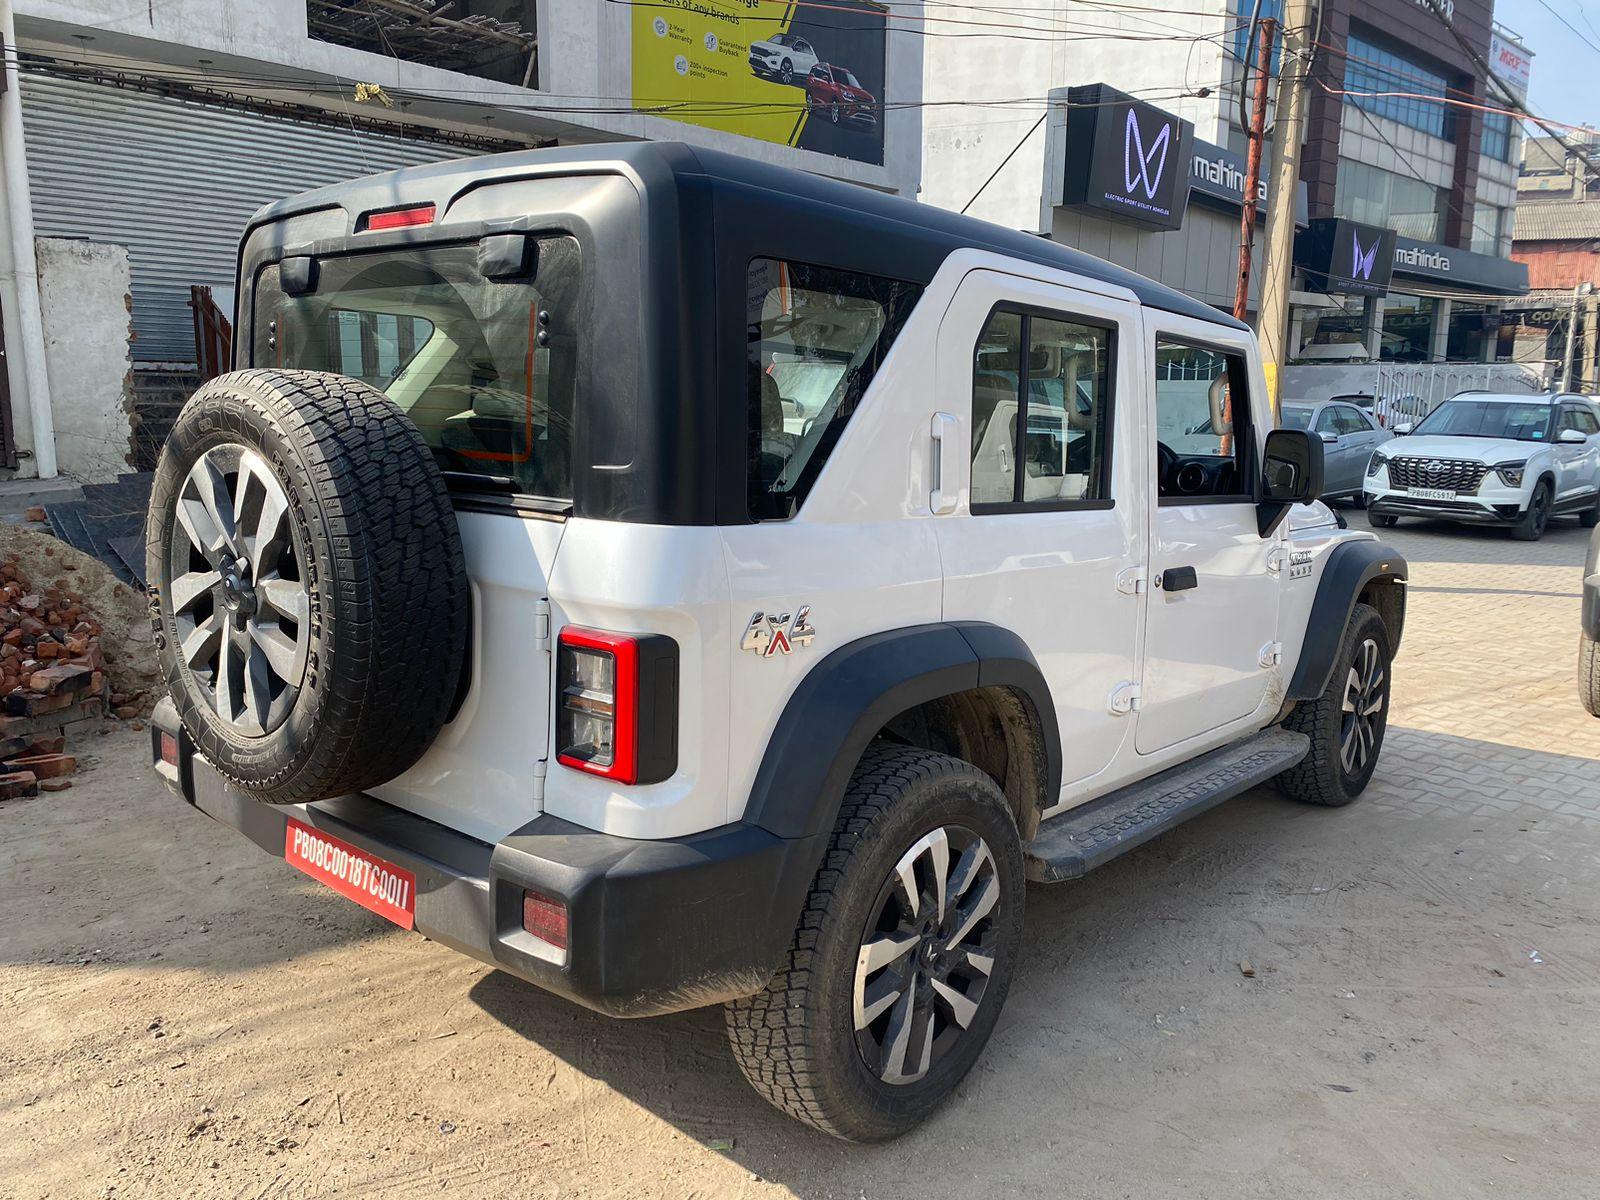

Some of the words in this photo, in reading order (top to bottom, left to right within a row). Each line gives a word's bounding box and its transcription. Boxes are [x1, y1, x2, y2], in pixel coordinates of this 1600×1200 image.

[682, 0, 692, 9] of
[694, 3, 710, 17] any
[711, 6, 740, 25] brands
[668, 32, 693, 44] Warranty
[718, 39, 747, 53] Guaranteed
[718, 46, 739, 57] Buyback
[689, 70, 706, 79] points
[1193, 155, 1268, 201] mahina
[1104, 192, 1124, 203] ELECTRIC
[1124, 197, 1138, 207] SPORT
[1137, 201, 1153, 211] UTILITY
[1395, 247, 1451, 271] mahindra
